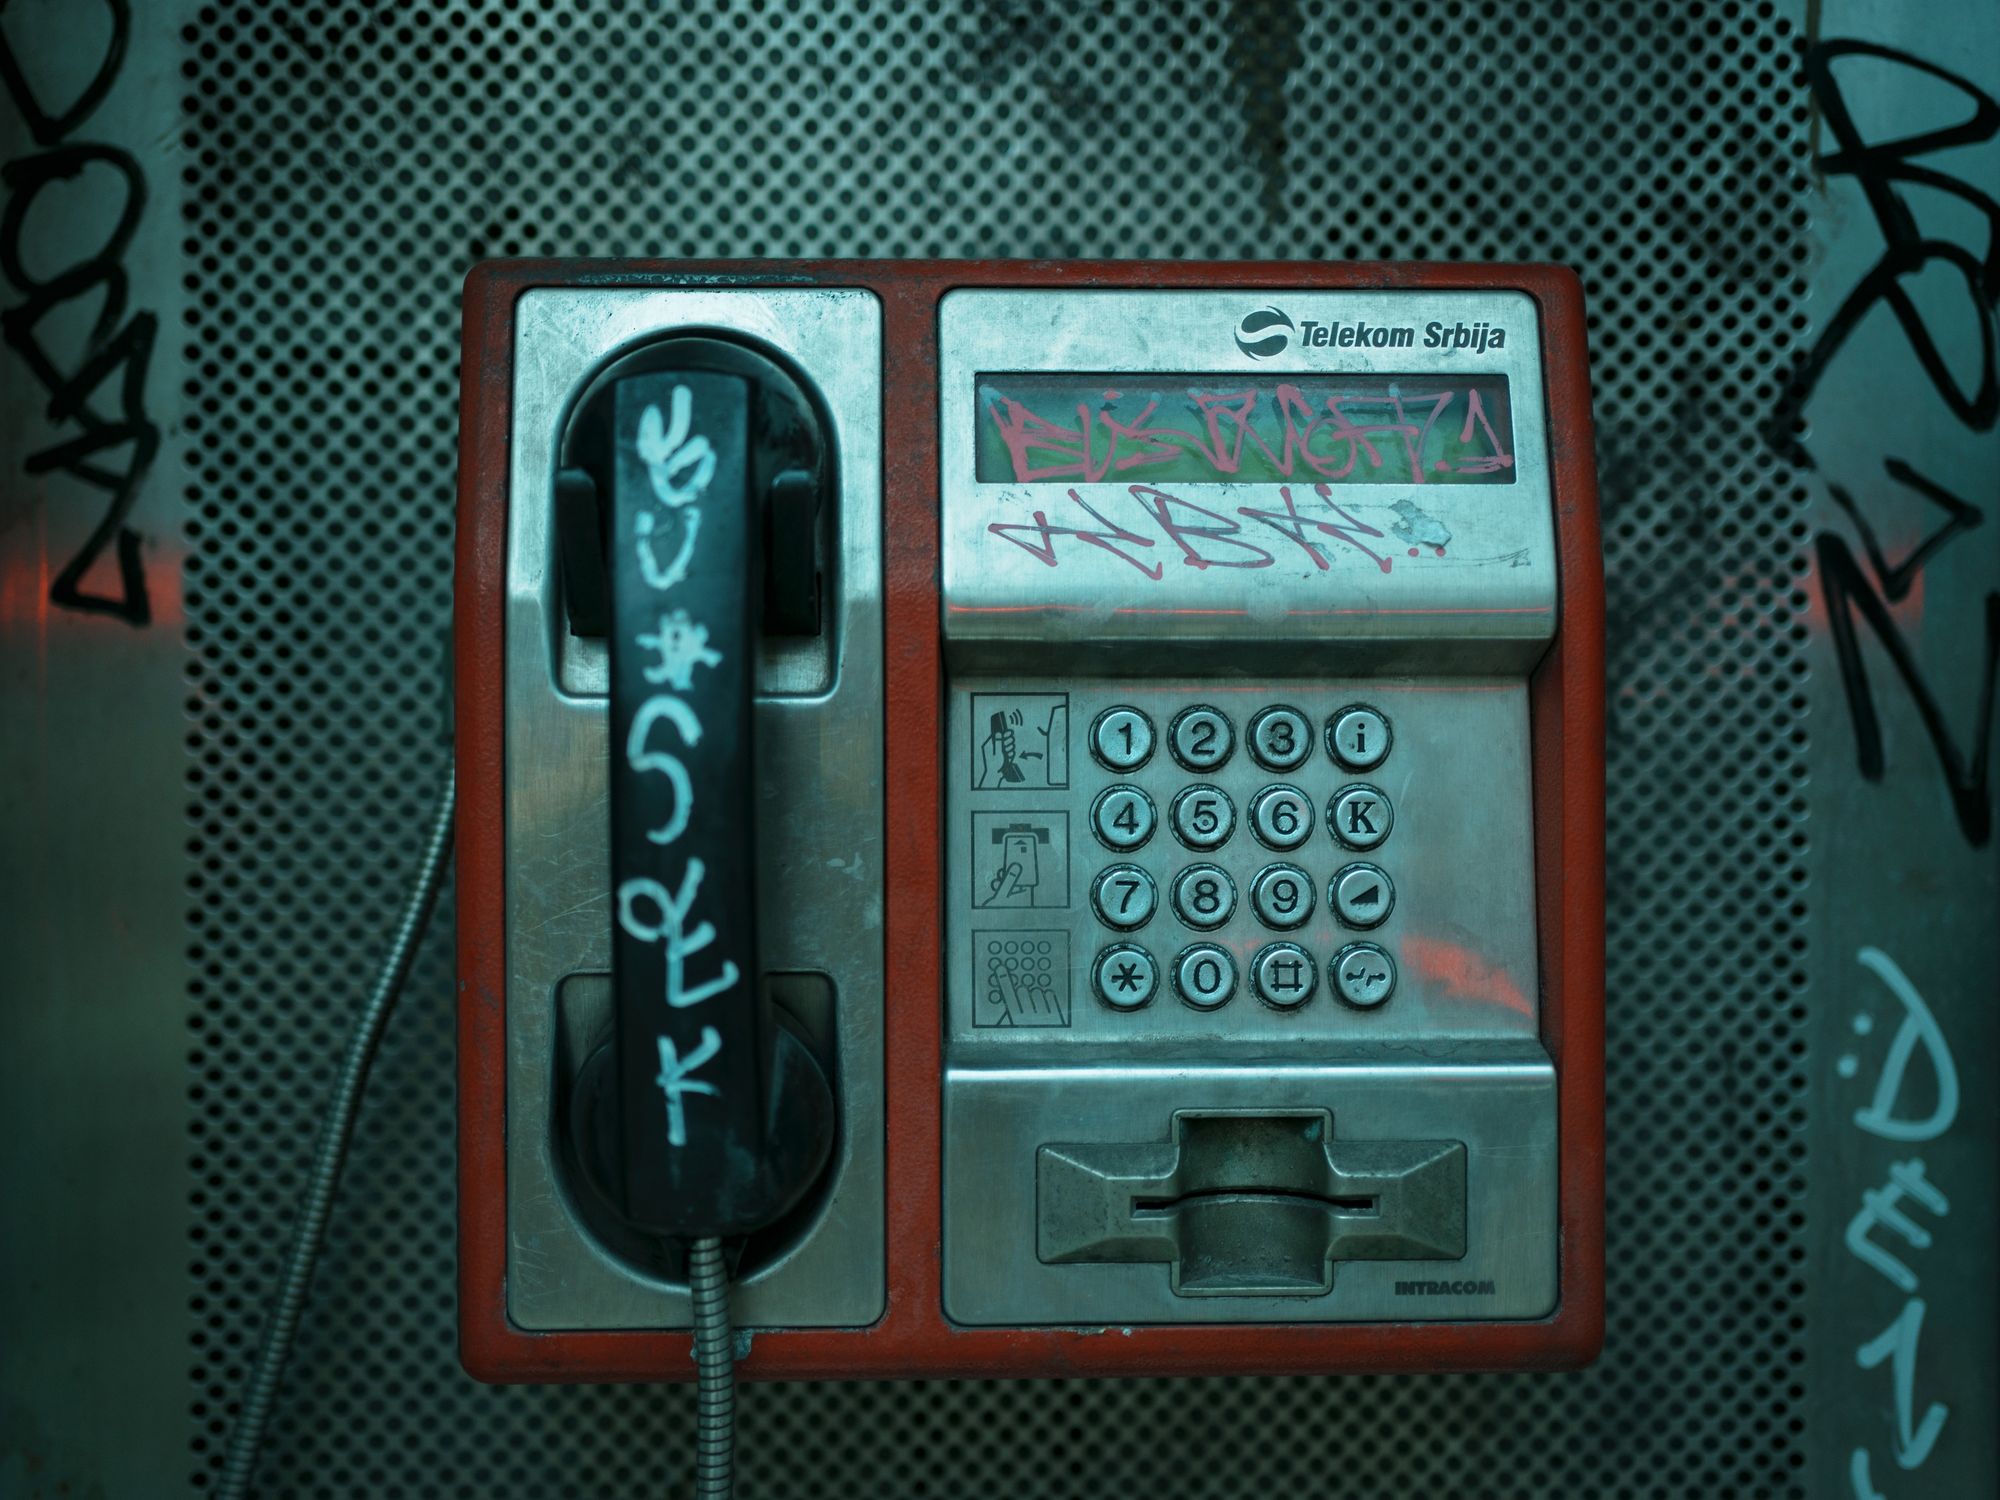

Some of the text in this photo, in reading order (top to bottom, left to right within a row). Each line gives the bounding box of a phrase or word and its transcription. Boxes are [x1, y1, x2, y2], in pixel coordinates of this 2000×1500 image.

[1300, 321, 1506, 354] Telekom Srbija
[1117, 721, 1367, 755] 1 2 3 i
[1112, 801, 1377, 835] 4 5 6 K
[1115, 879, 1298, 914] 7 8 9
[1193, 958, 1221, 994] 0
[1394, 1280, 1496, 1296] INTRACOM
